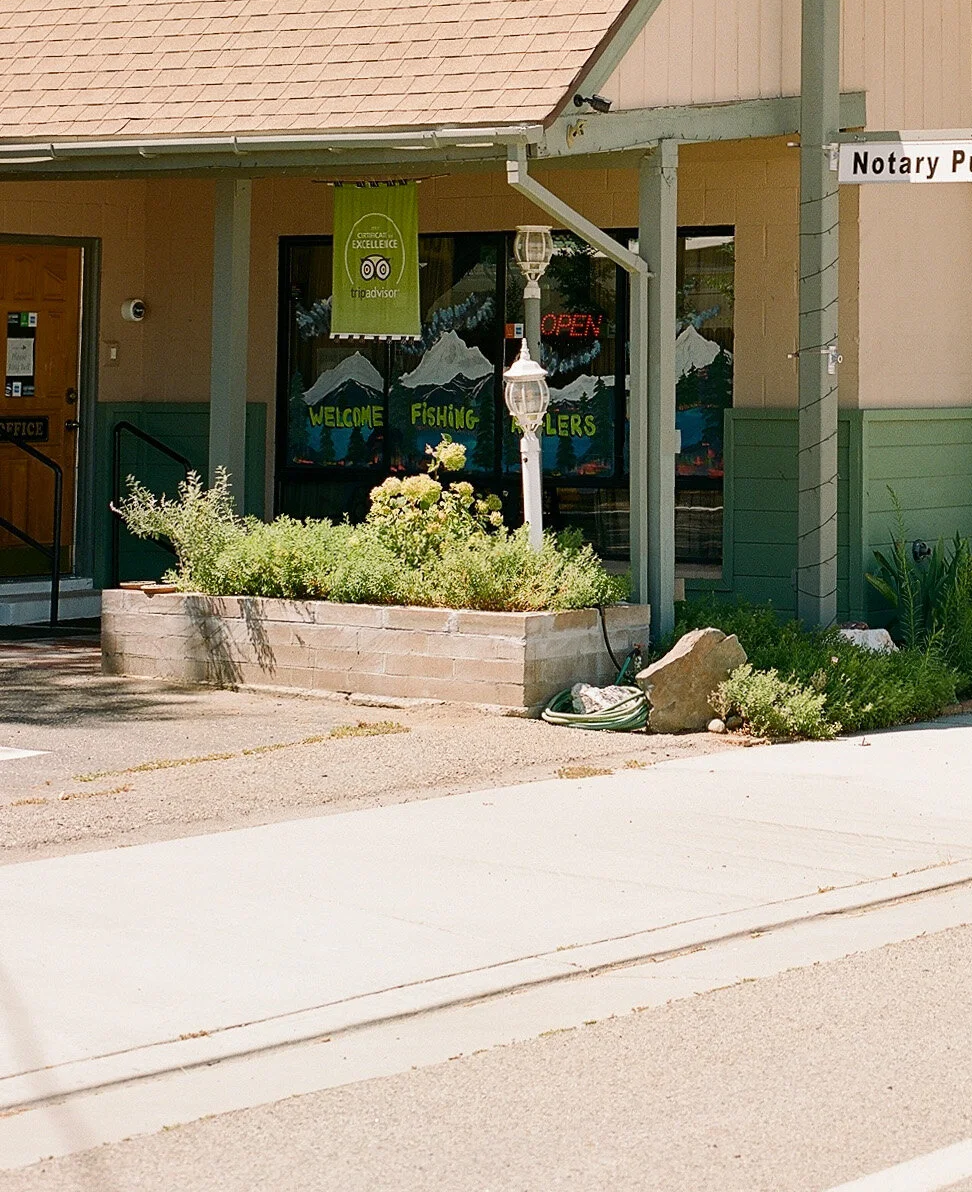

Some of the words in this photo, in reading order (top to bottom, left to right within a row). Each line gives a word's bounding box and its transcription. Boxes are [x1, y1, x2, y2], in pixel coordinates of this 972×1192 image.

[853, 151, 939, 179] Notary
[352, 239, 398, 249] EXCELLENCE
[541, 313, 602, 336] OPEN
[309, 405, 384, 428] WELCOME
